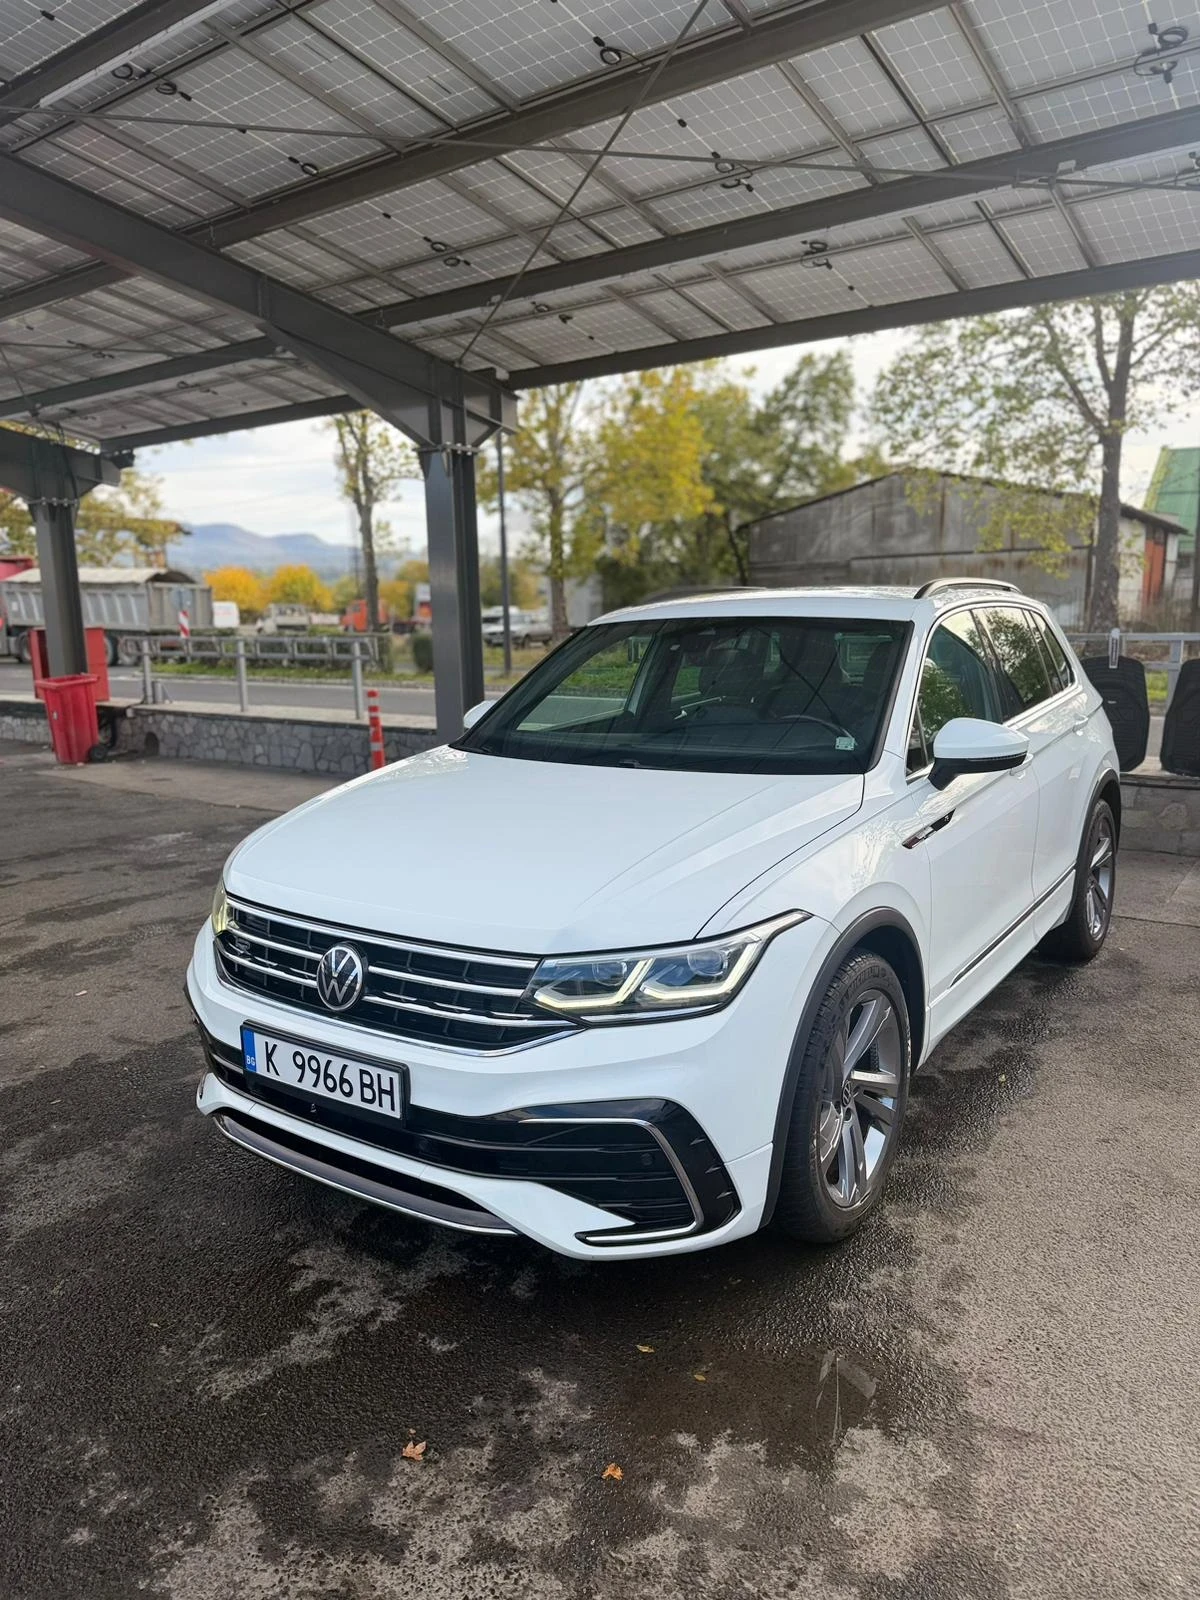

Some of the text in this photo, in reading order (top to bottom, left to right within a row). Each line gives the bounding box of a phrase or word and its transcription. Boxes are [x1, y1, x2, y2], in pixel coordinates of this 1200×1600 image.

[246, 1055, 256, 1067] BG
[265, 1041, 280, 1076] K
[292, 1050, 354, 1098] 9966
